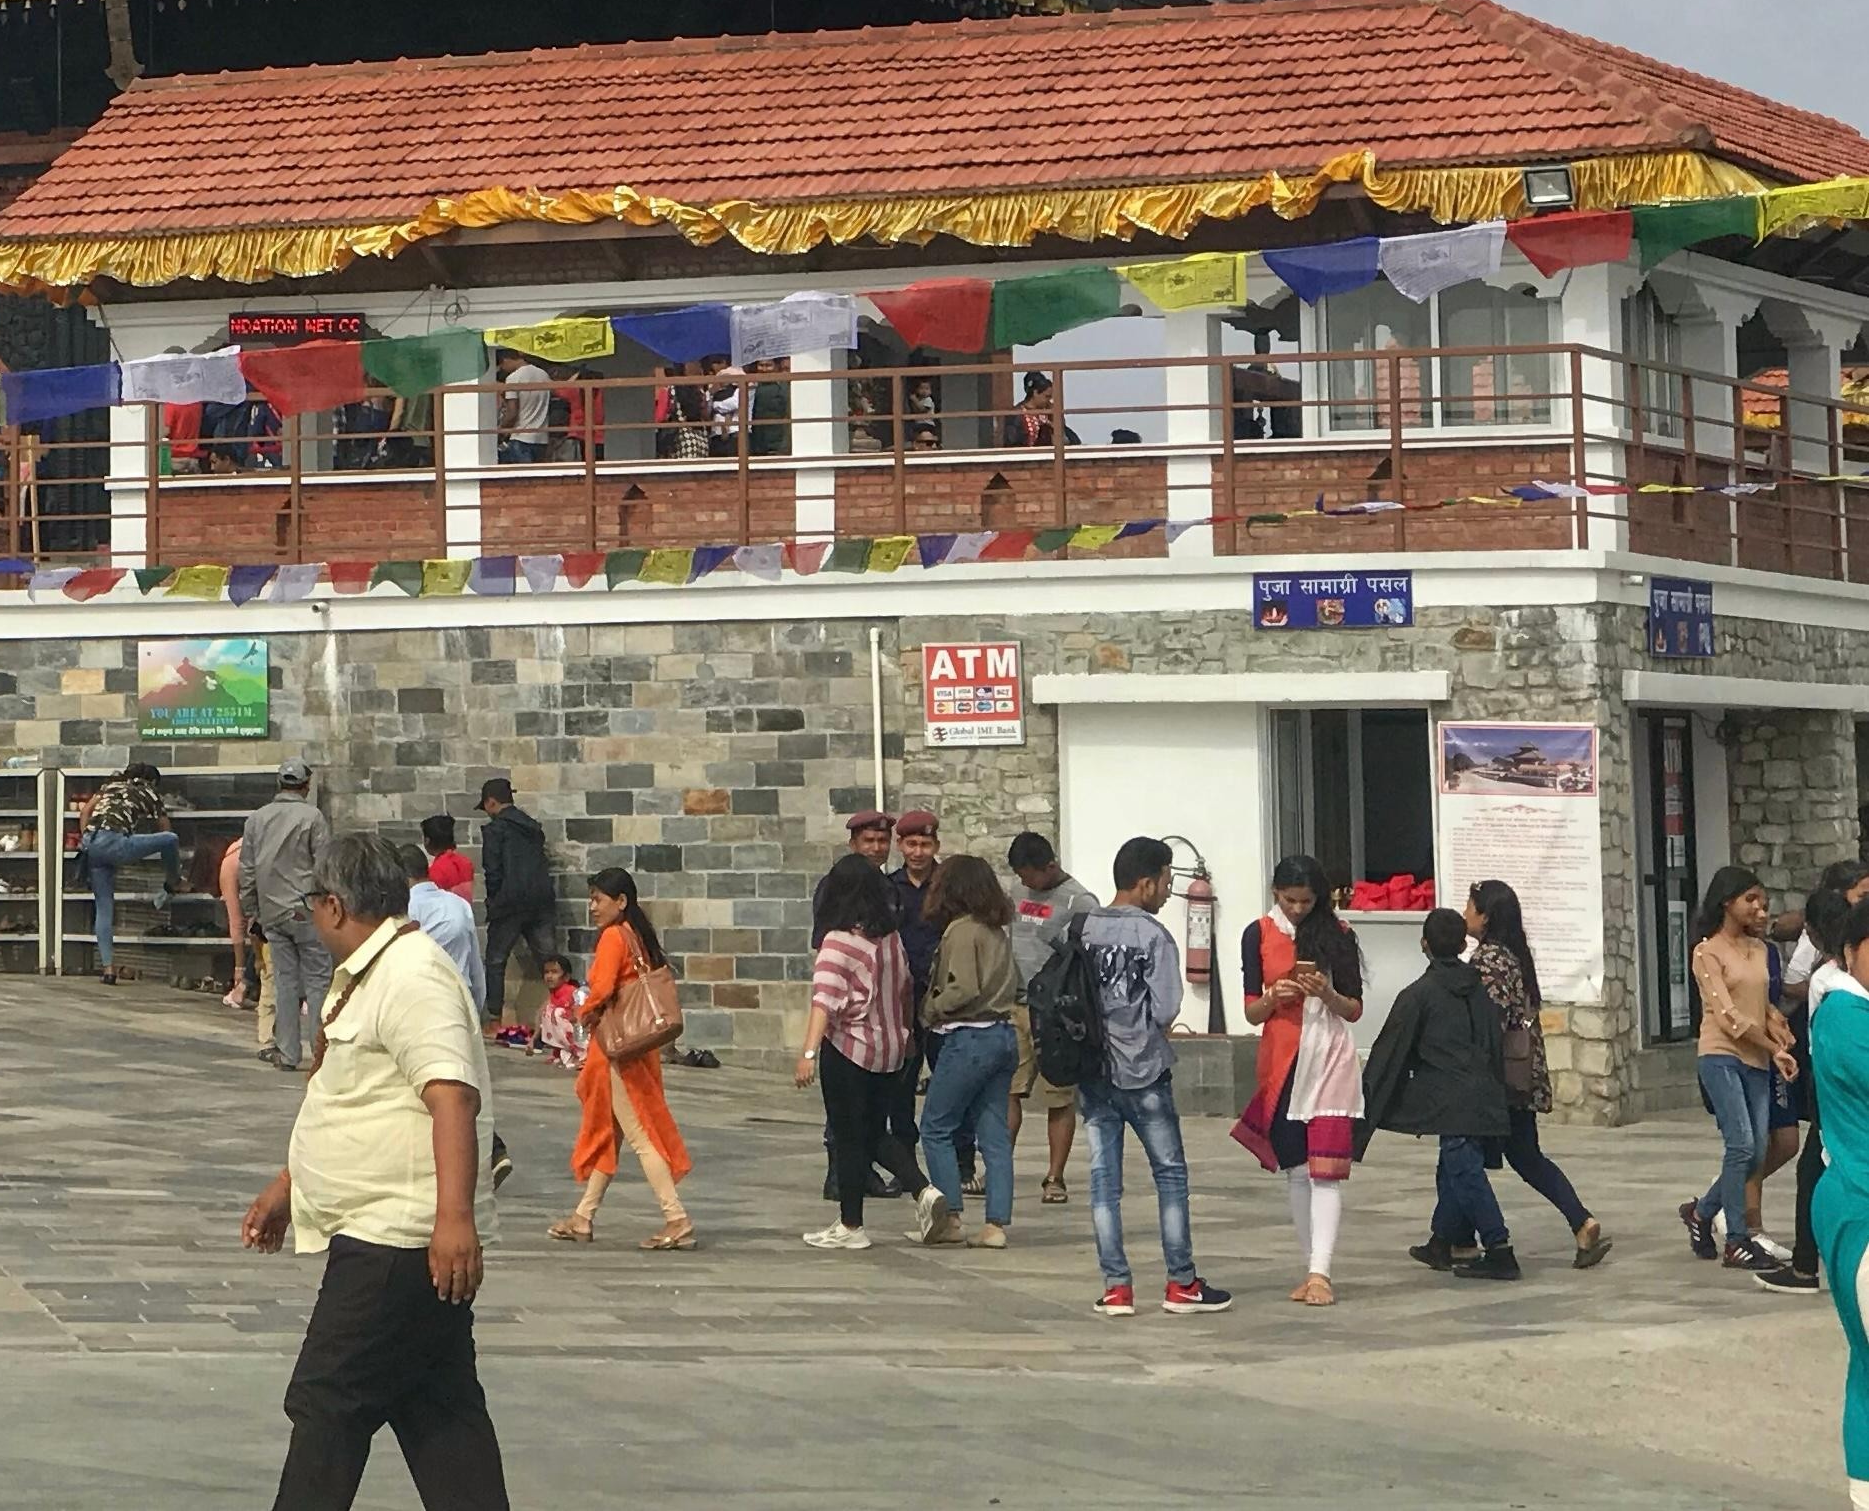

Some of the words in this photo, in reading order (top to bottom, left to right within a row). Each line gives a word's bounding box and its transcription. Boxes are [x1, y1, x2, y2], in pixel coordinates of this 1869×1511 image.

[305, 318, 334, 333] NET
[1259, 580, 1291, 601] पुजा
[1299, 573, 1358, 595] सामाग्री
[1366, 577, 1408, 593] पसल
[930, 648, 1017, 680] ATM
[997, 726, 1016, 734] Bank
